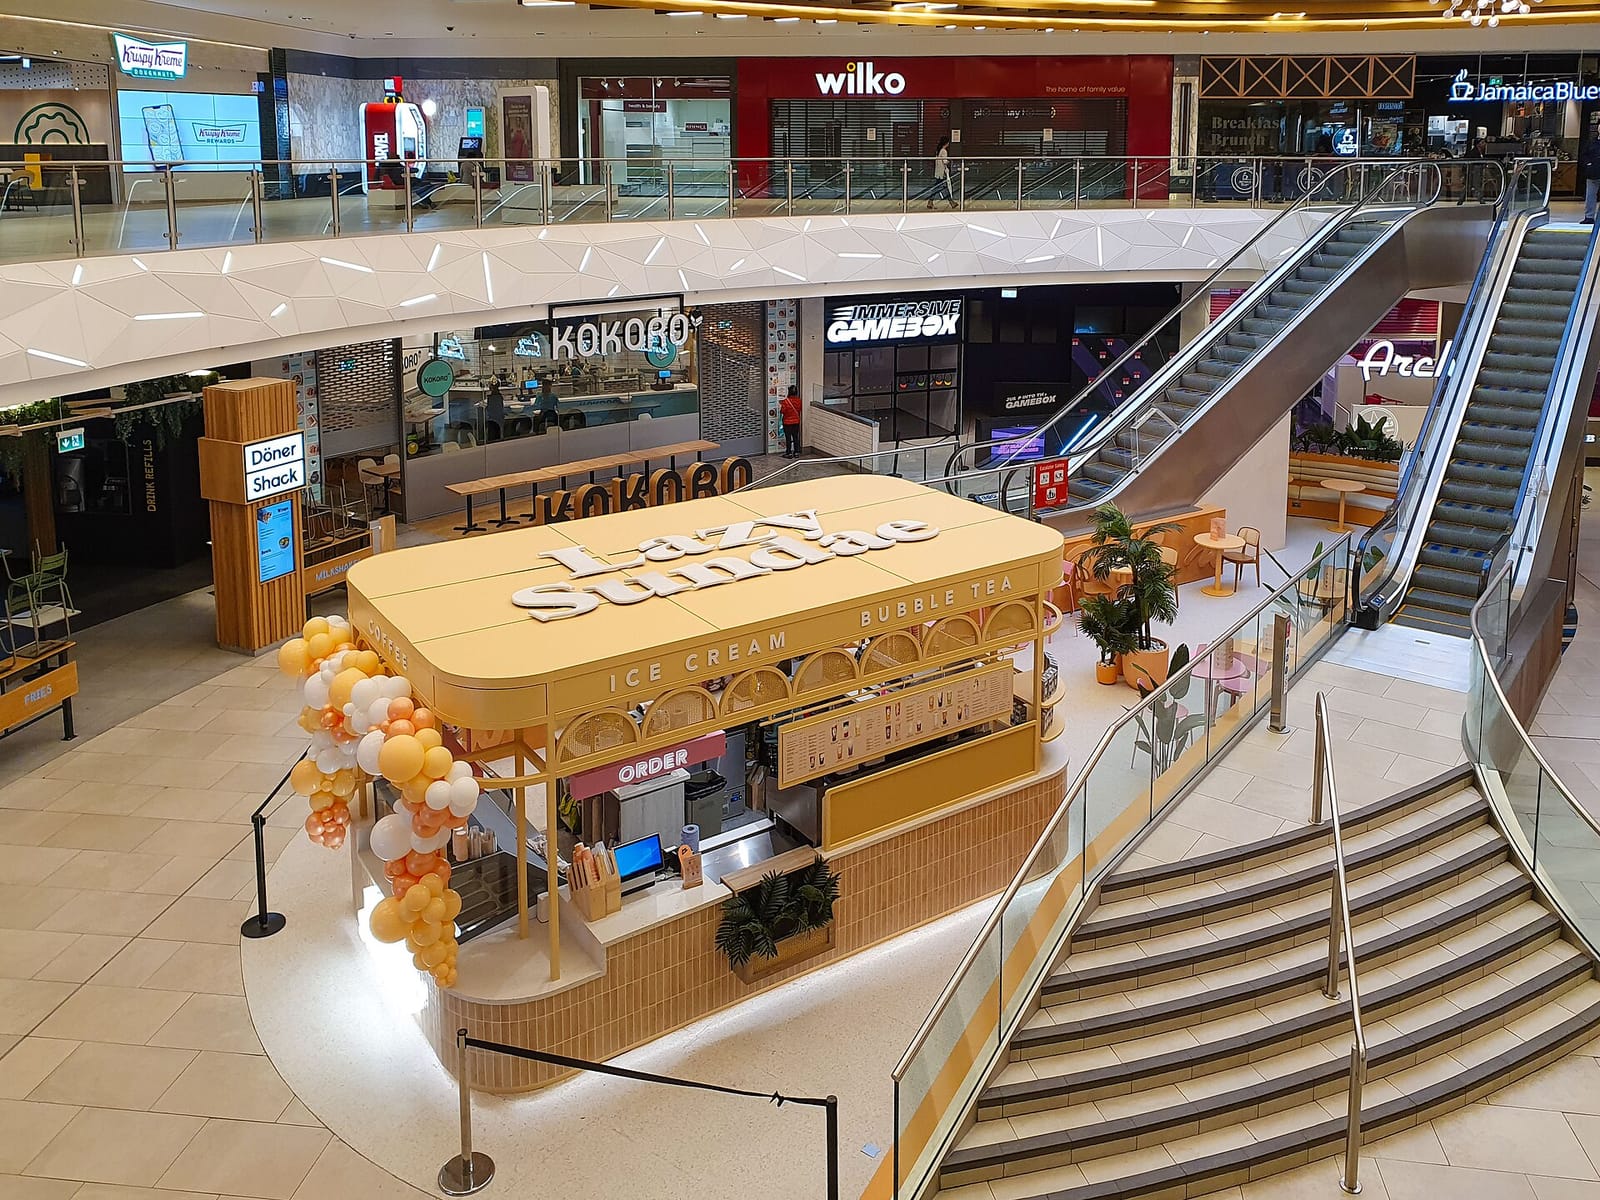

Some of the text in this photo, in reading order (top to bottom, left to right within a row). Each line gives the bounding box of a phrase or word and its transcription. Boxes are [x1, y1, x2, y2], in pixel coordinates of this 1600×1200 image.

[123, 44, 183, 68] Krispy Kreme
[133, 68, 174, 78] DOUGHNUTS
[815, 61, 906, 95] wilko
[1086, 86, 1107, 94] family
[1474, 80, 1599, 101] Jamaica Blue
[1211, 133, 1266, 147] Brunch
[851, 299, 962, 321] IMMERSIVE
[551, 313, 690, 361] KOKORO
[826, 313, 961, 343] GAMEBOX
[423, 375, 449, 384] KOKORO
[1005, 395, 1057, 409] GAMEBOX
[251, 443, 297, 466] Döner
[143, 439, 157, 512] DRINK REFILLS
[253, 467, 298, 493] Shack
[536, 508, 825, 579] Lazy
[511, 518, 940, 624] Sundae
[859, 574, 1013, 627] BUBBLE TEA
[368, 619, 408, 671] COFFEE
[609, 630, 786, 694] ICE CREAM
[24, 683, 53, 705] FRIES
[618, 748, 689, 783] ORDER
